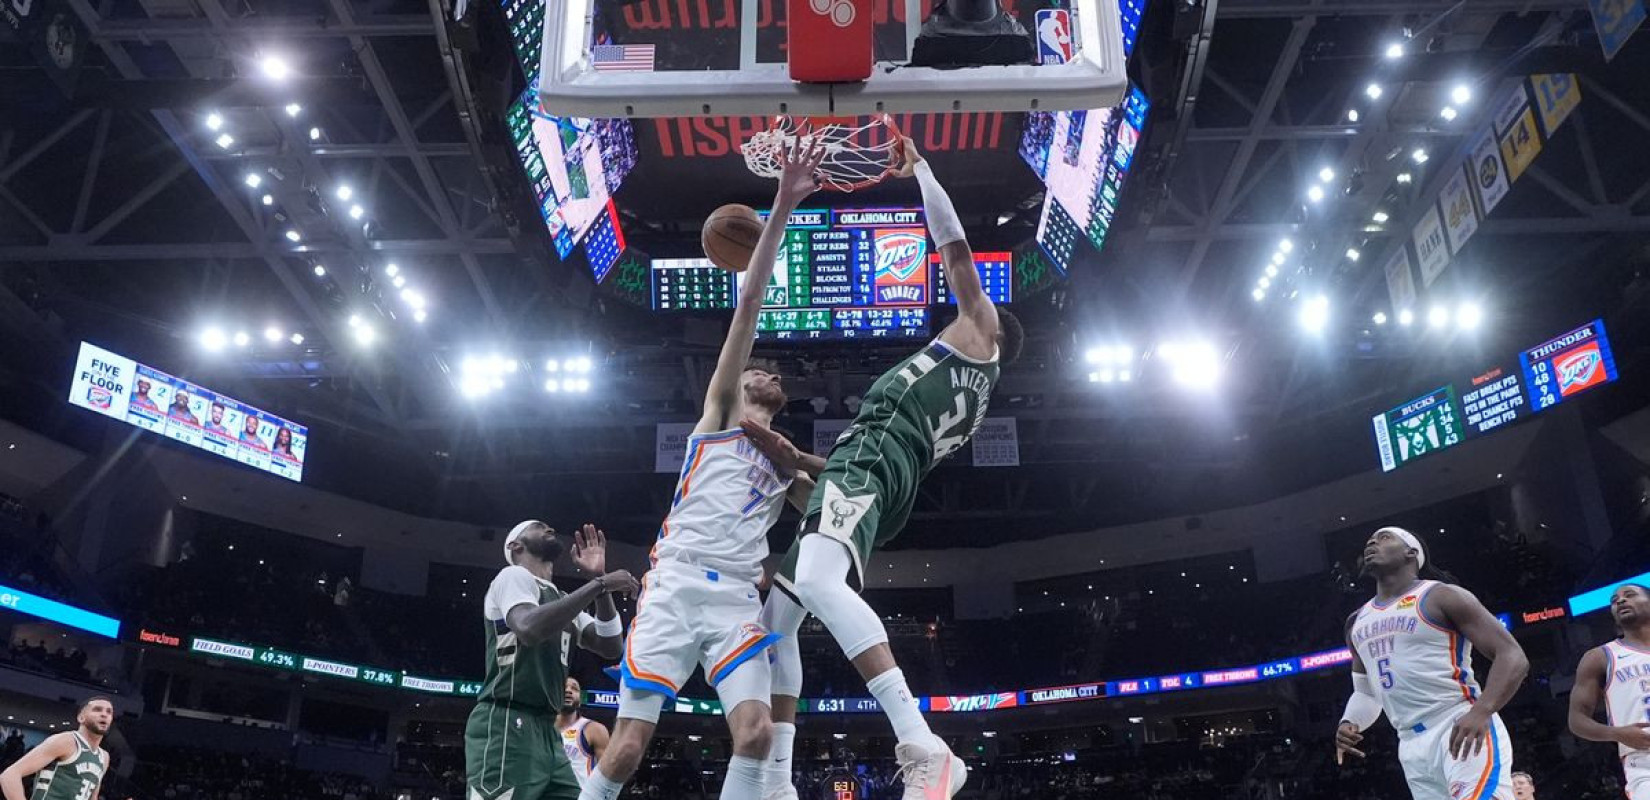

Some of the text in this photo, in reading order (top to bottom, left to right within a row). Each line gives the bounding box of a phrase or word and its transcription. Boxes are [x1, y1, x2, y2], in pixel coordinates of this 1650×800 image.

[1508, 122, 1529, 156] 14
[840, 213, 917, 224] OKLAHOMA CITY
[829, 232, 849, 240] REBS
[813, 243, 828, 251] DEF
[858, 242, 869, 250] 32
[858, 253, 869, 261] 21
[880, 285, 921, 301] THUNDER
[796, 296, 867, 305] 1 CHALLENGES 1
[772, 312, 797, 321] 14-37
[835, 309, 924, 319] 43-78 13-32 10-15
[805, 321, 827, 329] 66.7%
[901, 318, 923, 327] 66.7%
[777, 330, 820, 339] 3PT FT
[843, 329, 855, 337] FG
[905, 328, 916, 336] FT
[1532, 328, 1592, 359] THUNDER
[92, 358, 120, 377] FIVE
[1532, 362, 1546, 375] 10
[81, 371, 123, 394] FLOOR
[1535, 373, 1549, 386] 48
[157, 387, 167, 398] 2
[1463, 390, 1479, 404] FAST
[1480, 381, 1503, 398] BREAK
[1502, 375, 1517, 388] PTS
[1540, 384, 1548, 396] 9
[1402, 396, 1435, 416] BUCKS
[1465, 385, 1520, 415] PTS IN THE PAINT
[1540, 393, 1555, 408] 28
[1438, 402, 1451, 415] 14
[1467, 395, 1524, 426] 2ND CHANCE PTS
[229, 413, 237, 423] 7
[1440, 413, 1453, 426] 34
[1478, 409, 1517, 432] BENCH PTS
[260, 425, 273, 438] 11
[1445, 423, 1453, 434] 5
[1445, 433, 1458, 445] 43
[741, 487, 764, 515] 7
[194, 641, 252, 659] FIELD GOALS
[560, 631, 571, 666] 9
[1368, 634, 1395, 658] CITY
[260, 652, 294, 667] 49.3%
[305, 661, 357, 677] 3-POINTERS
[1262, 662, 1292, 677] 66.7%
[1377, 658, 1393, 689] 5
[363, 670, 393, 684] 37.8%
[1185, 676, 1192, 685] 4
[404, 679, 452, 692] FREE THROWS
[460, 683, 482, 694] 66.7
[1144, 681, 1149, 690] 1
[1032, 685, 1098, 702] OKLAHOMA CITY
[817, 699, 845, 711] 6:31
[857, 699, 877, 710] 4TH
